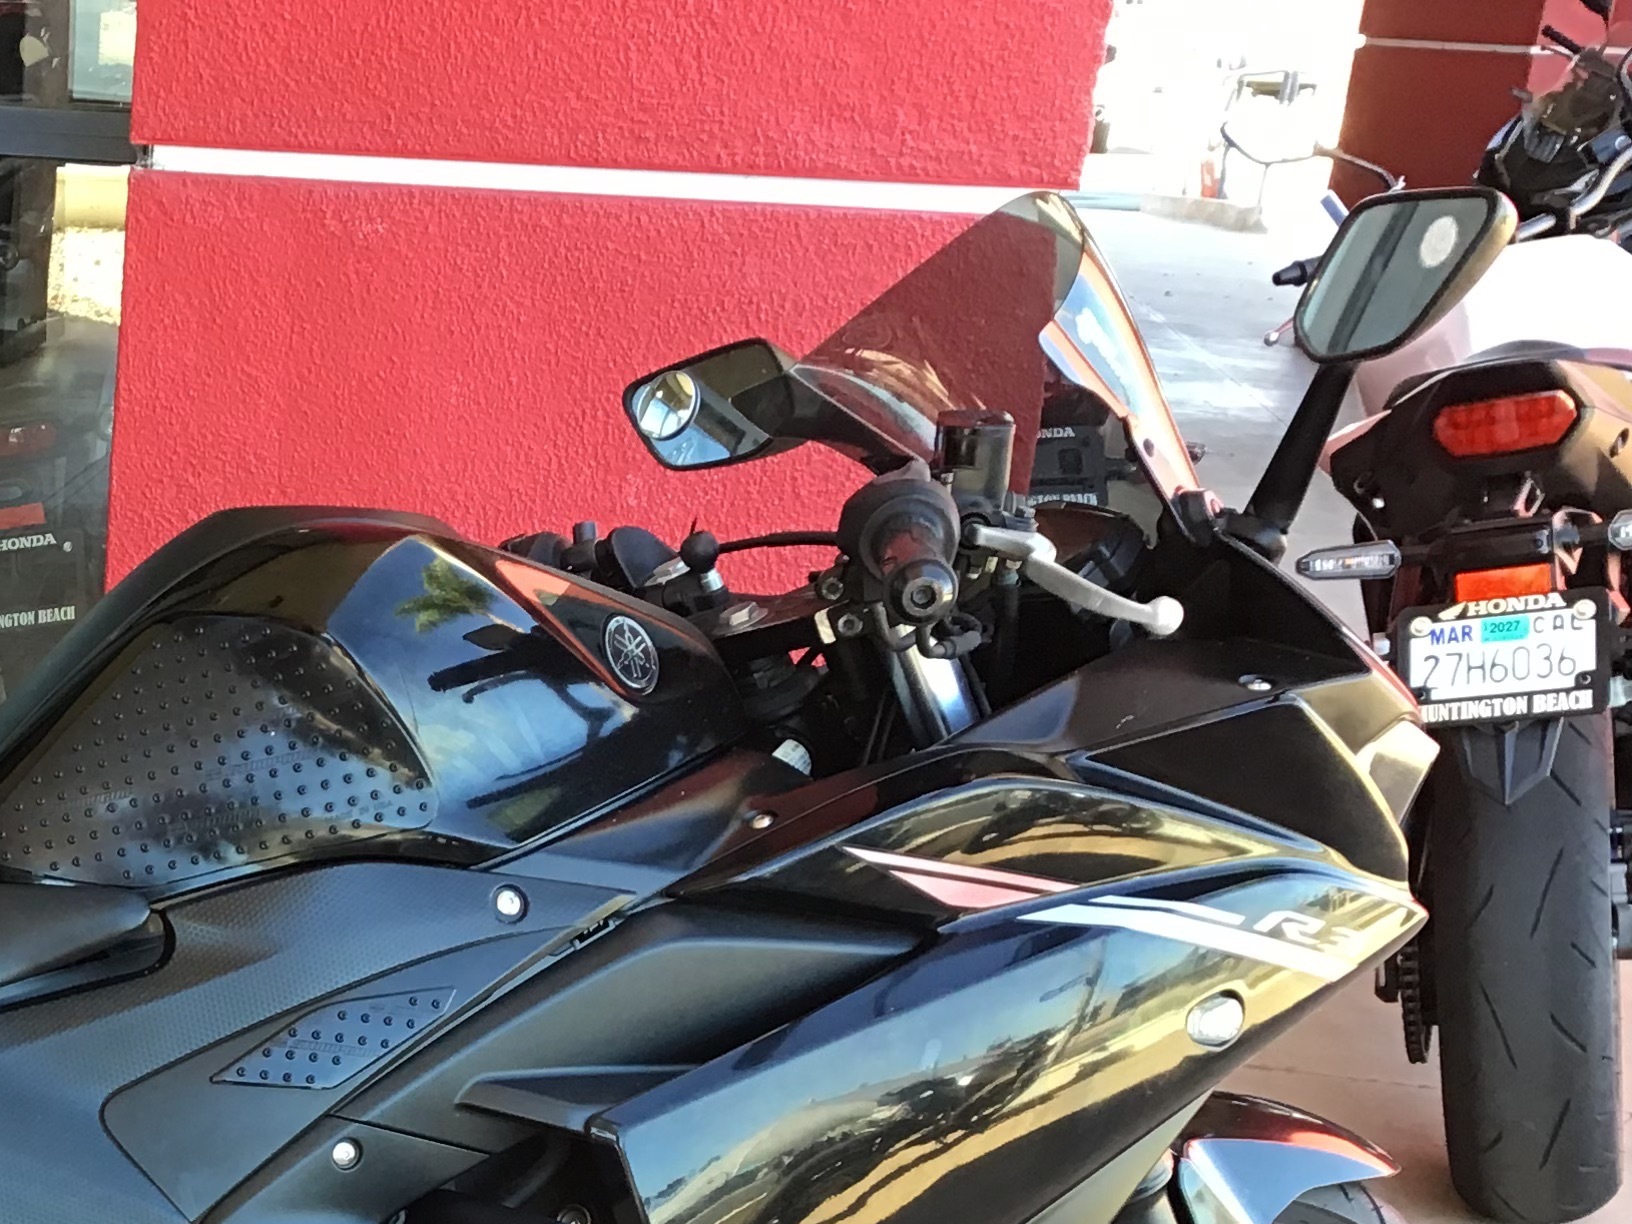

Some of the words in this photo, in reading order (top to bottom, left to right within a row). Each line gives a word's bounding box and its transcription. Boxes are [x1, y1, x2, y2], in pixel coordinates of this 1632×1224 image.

[38, 606, 75, 624] BEACH
[1467, 593, 1567, 616] HONDA
[1430, 625, 1473, 645] MAR
[1490, 620, 1521, 633] 2027
[1532, 689, 1593, 713] BEACH
